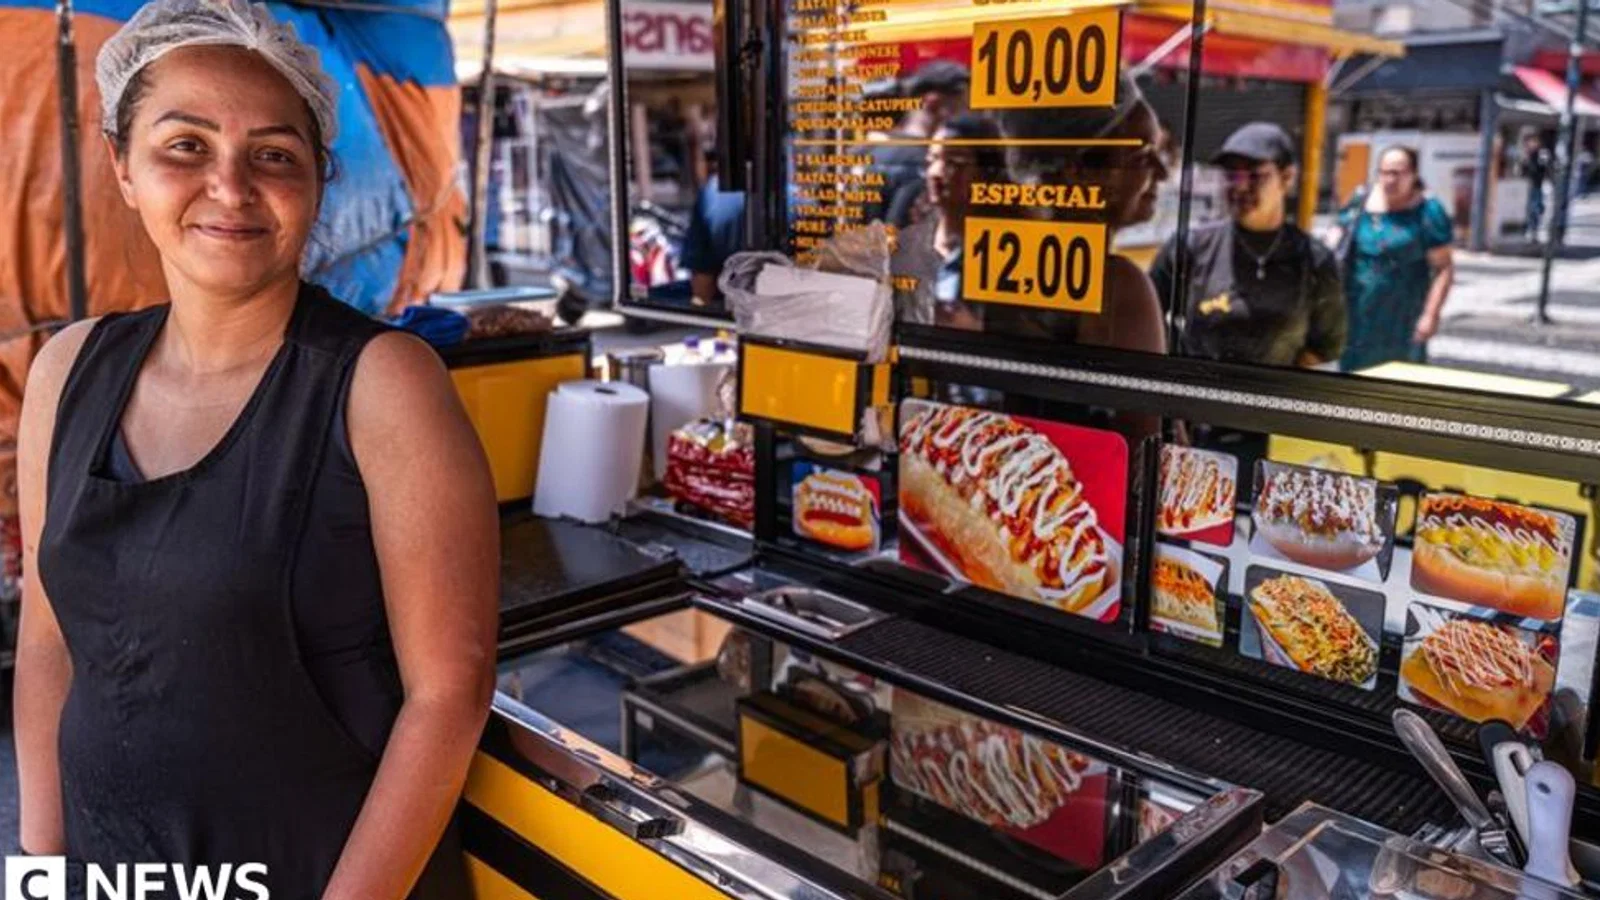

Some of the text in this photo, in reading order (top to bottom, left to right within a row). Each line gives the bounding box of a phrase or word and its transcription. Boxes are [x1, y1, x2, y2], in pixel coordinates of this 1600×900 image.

[978, 25, 1106, 102] 10,00
[970, 183, 1106, 208] ESPECIAL
[972, 229, 1092, 301] 12,00
